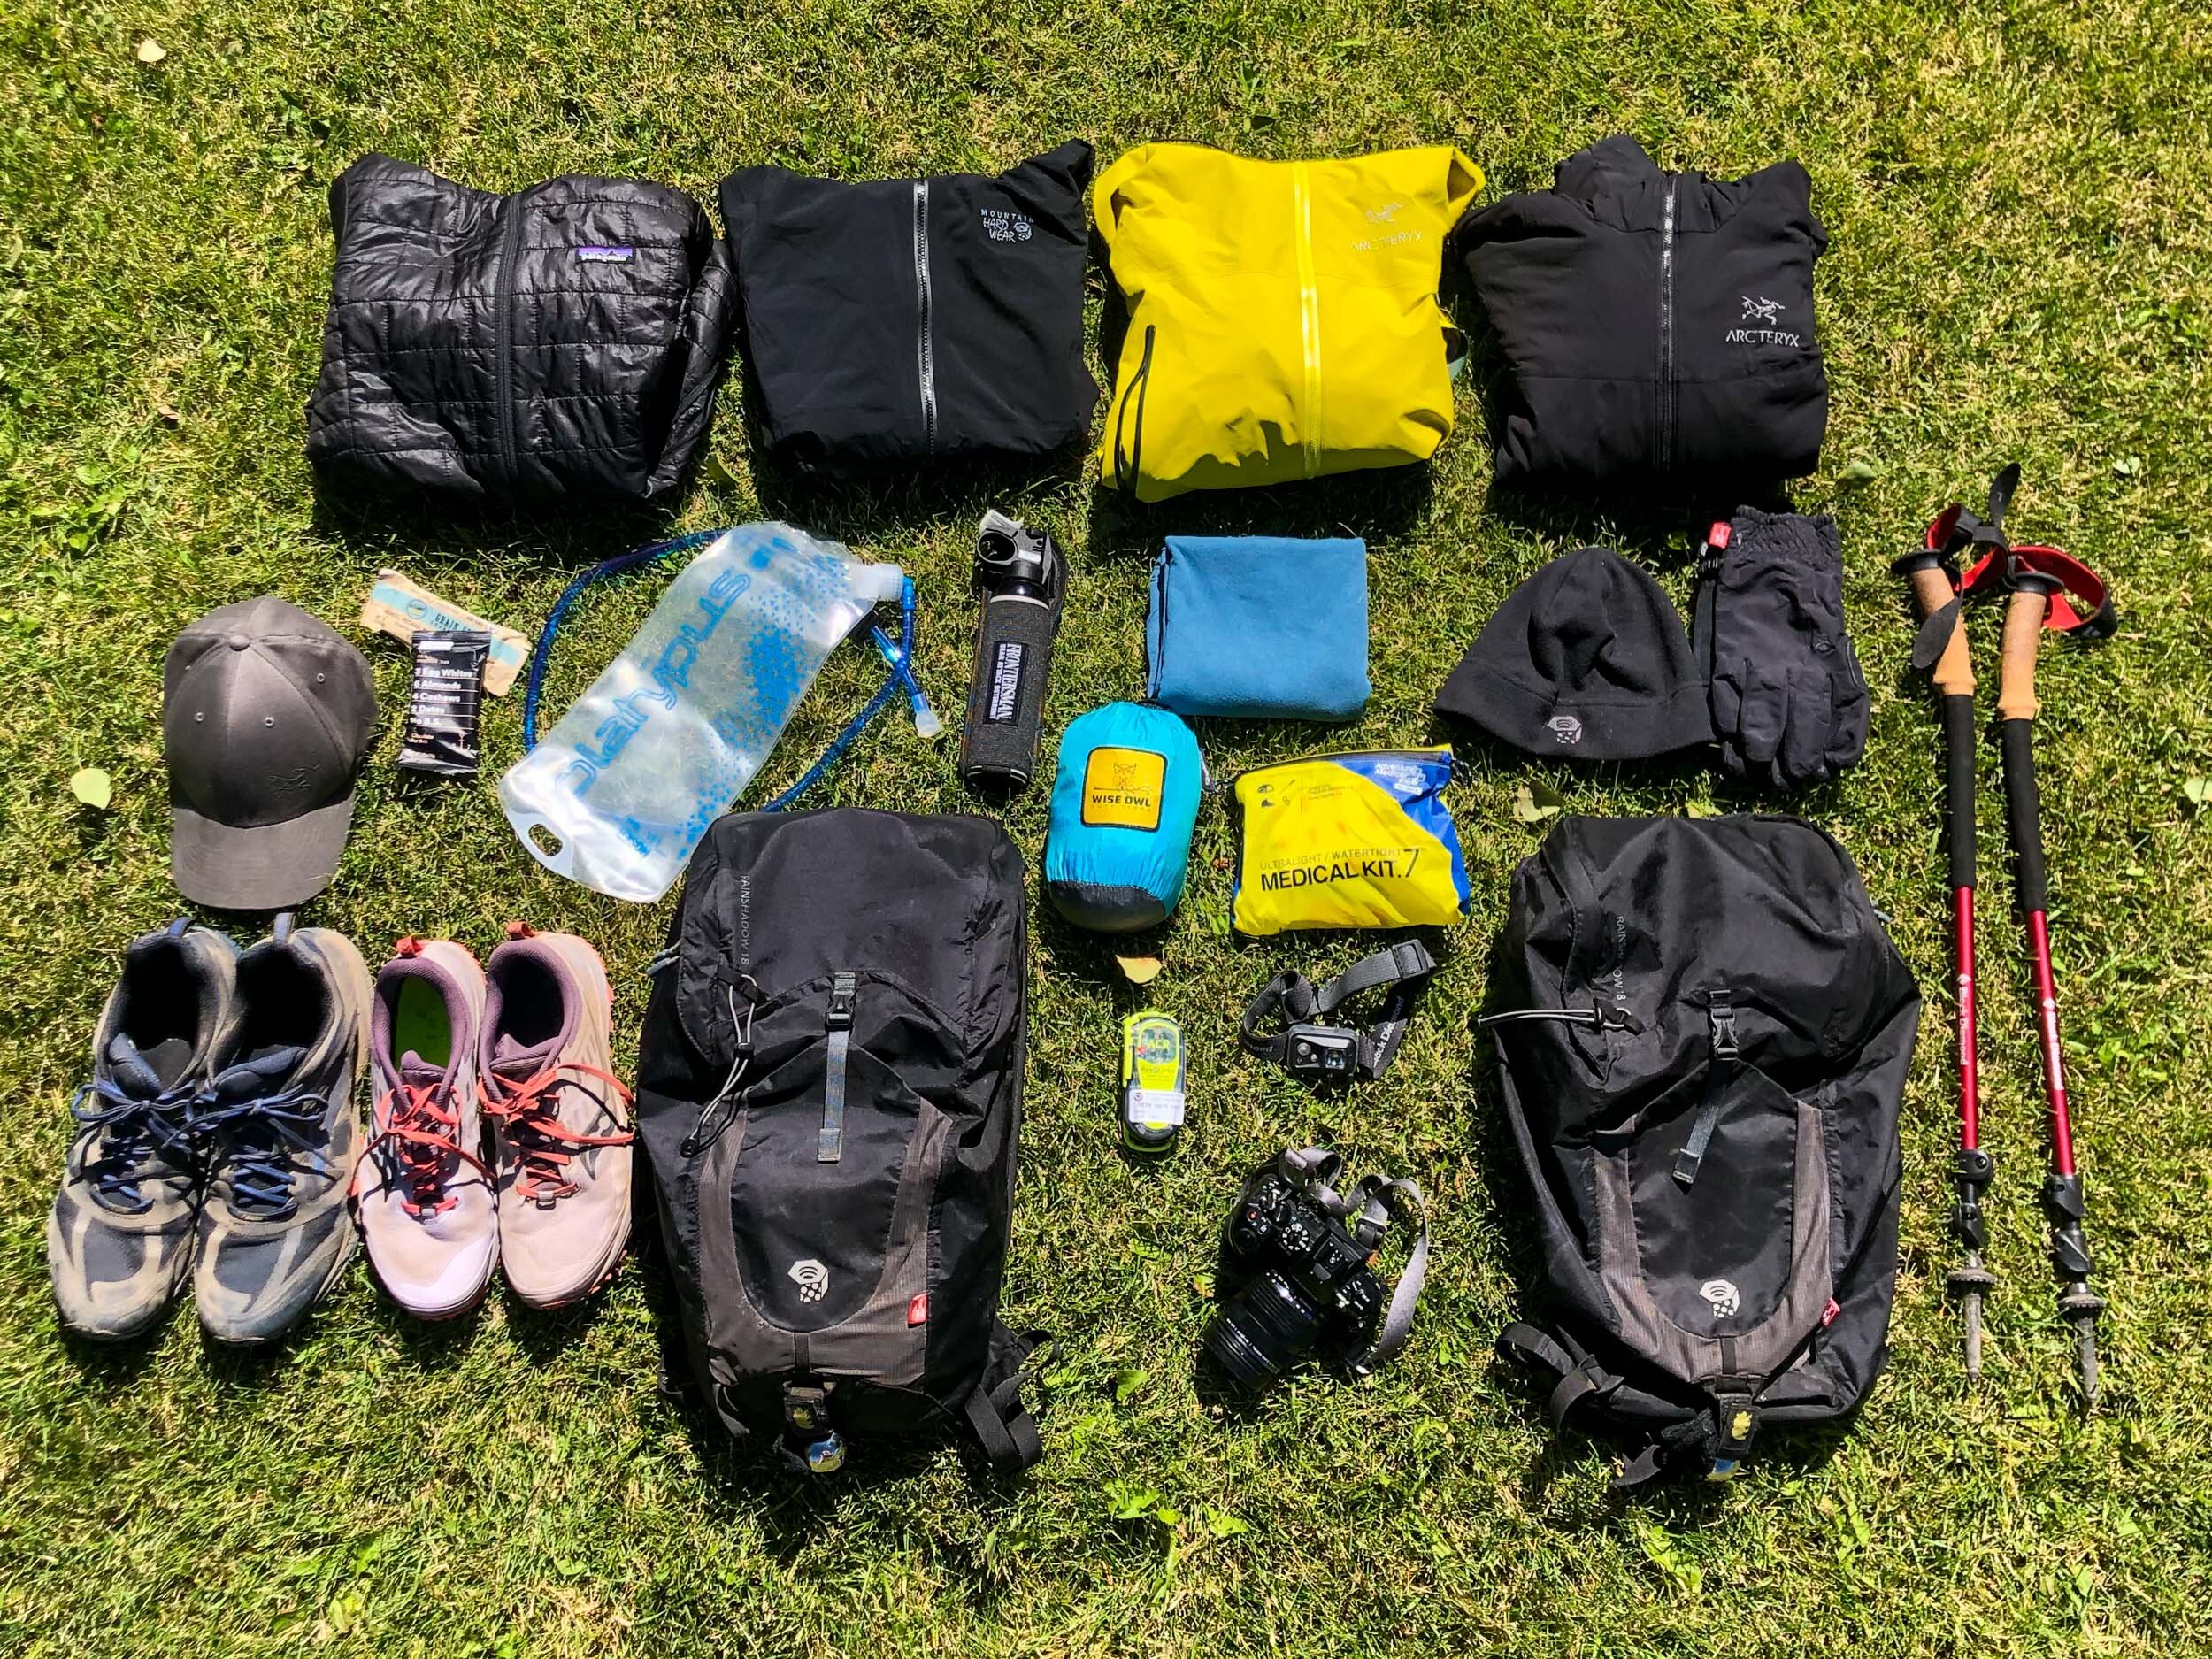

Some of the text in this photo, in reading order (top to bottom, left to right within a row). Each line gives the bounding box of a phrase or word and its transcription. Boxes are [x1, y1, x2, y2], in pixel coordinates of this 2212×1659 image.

[980, 208, 1034, 223] MOUNTAIN
[982, 217, 1009, 232] HARD
[988, 228, 1017, 243] WEAR
[421, 680, 462, 690] Almonds
[1092, 795, 1151, 808] WISE OWL
[1260, 853, 1322, 871] ULTRALIGHT
[1332, 848, 1402, 861] WATERTIGHT
[1261, 862, 1360, 892] MEDICAL
[740, 875, 751, 964] RAINSHADOW 18
[1612, 915, 1628, 989] RAINSHOW
